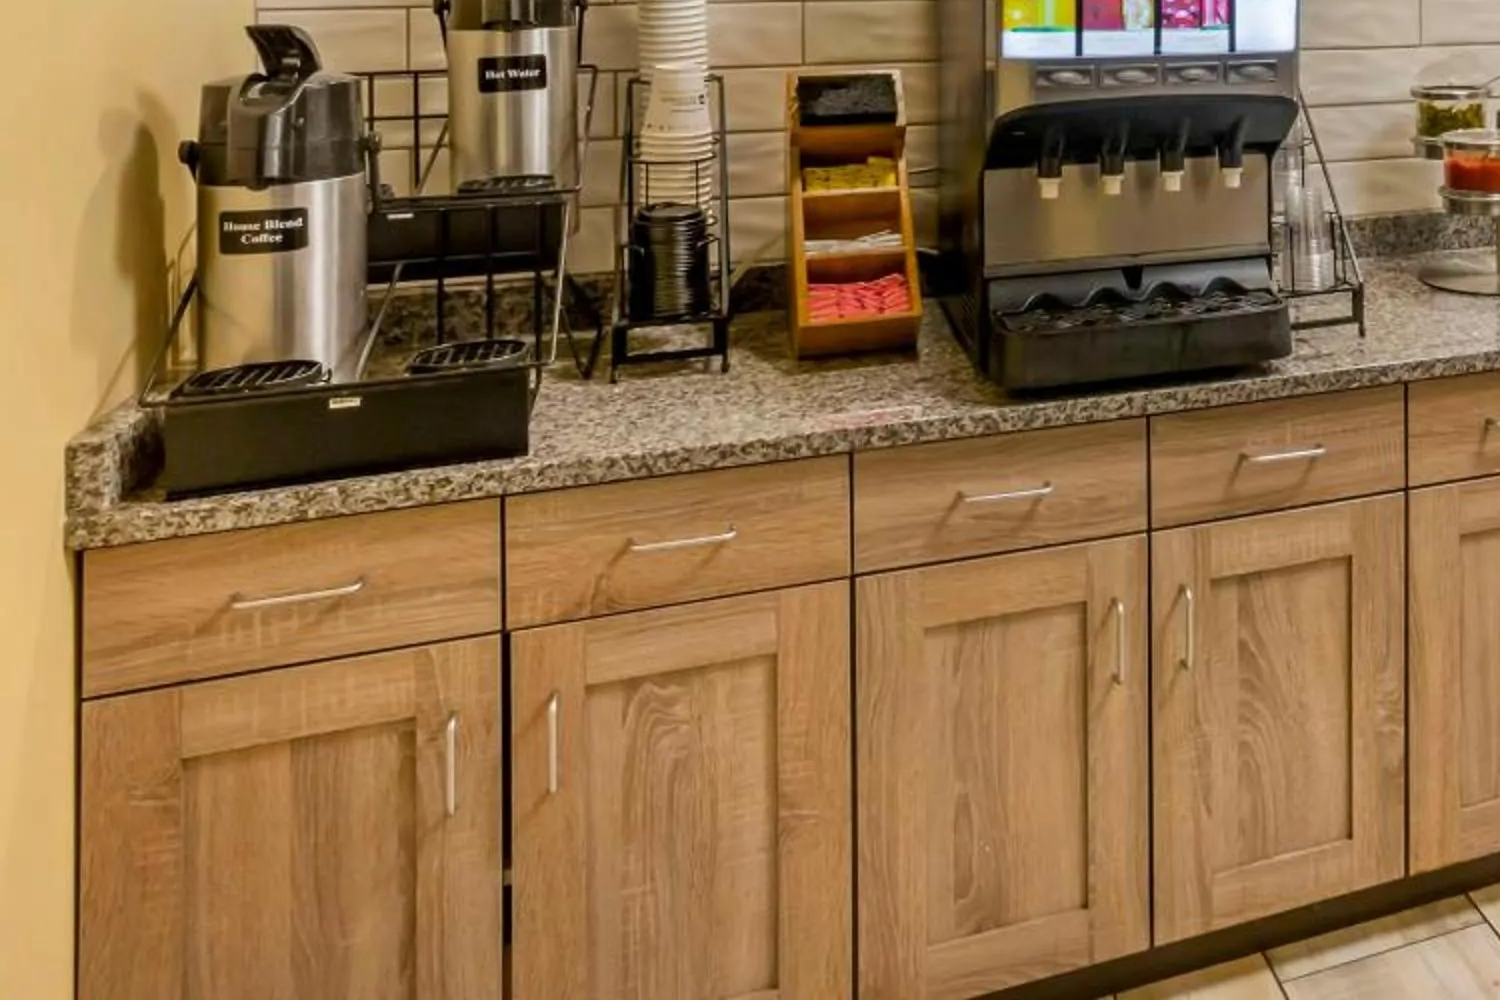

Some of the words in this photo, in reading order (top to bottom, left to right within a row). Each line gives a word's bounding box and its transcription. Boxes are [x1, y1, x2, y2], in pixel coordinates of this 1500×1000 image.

[485, 69, 505, 80] Hot
[507, 67, 541, 79] Water
[265, 217, 303, 231] Blend
[240, 233, 283, 245] Coffee
